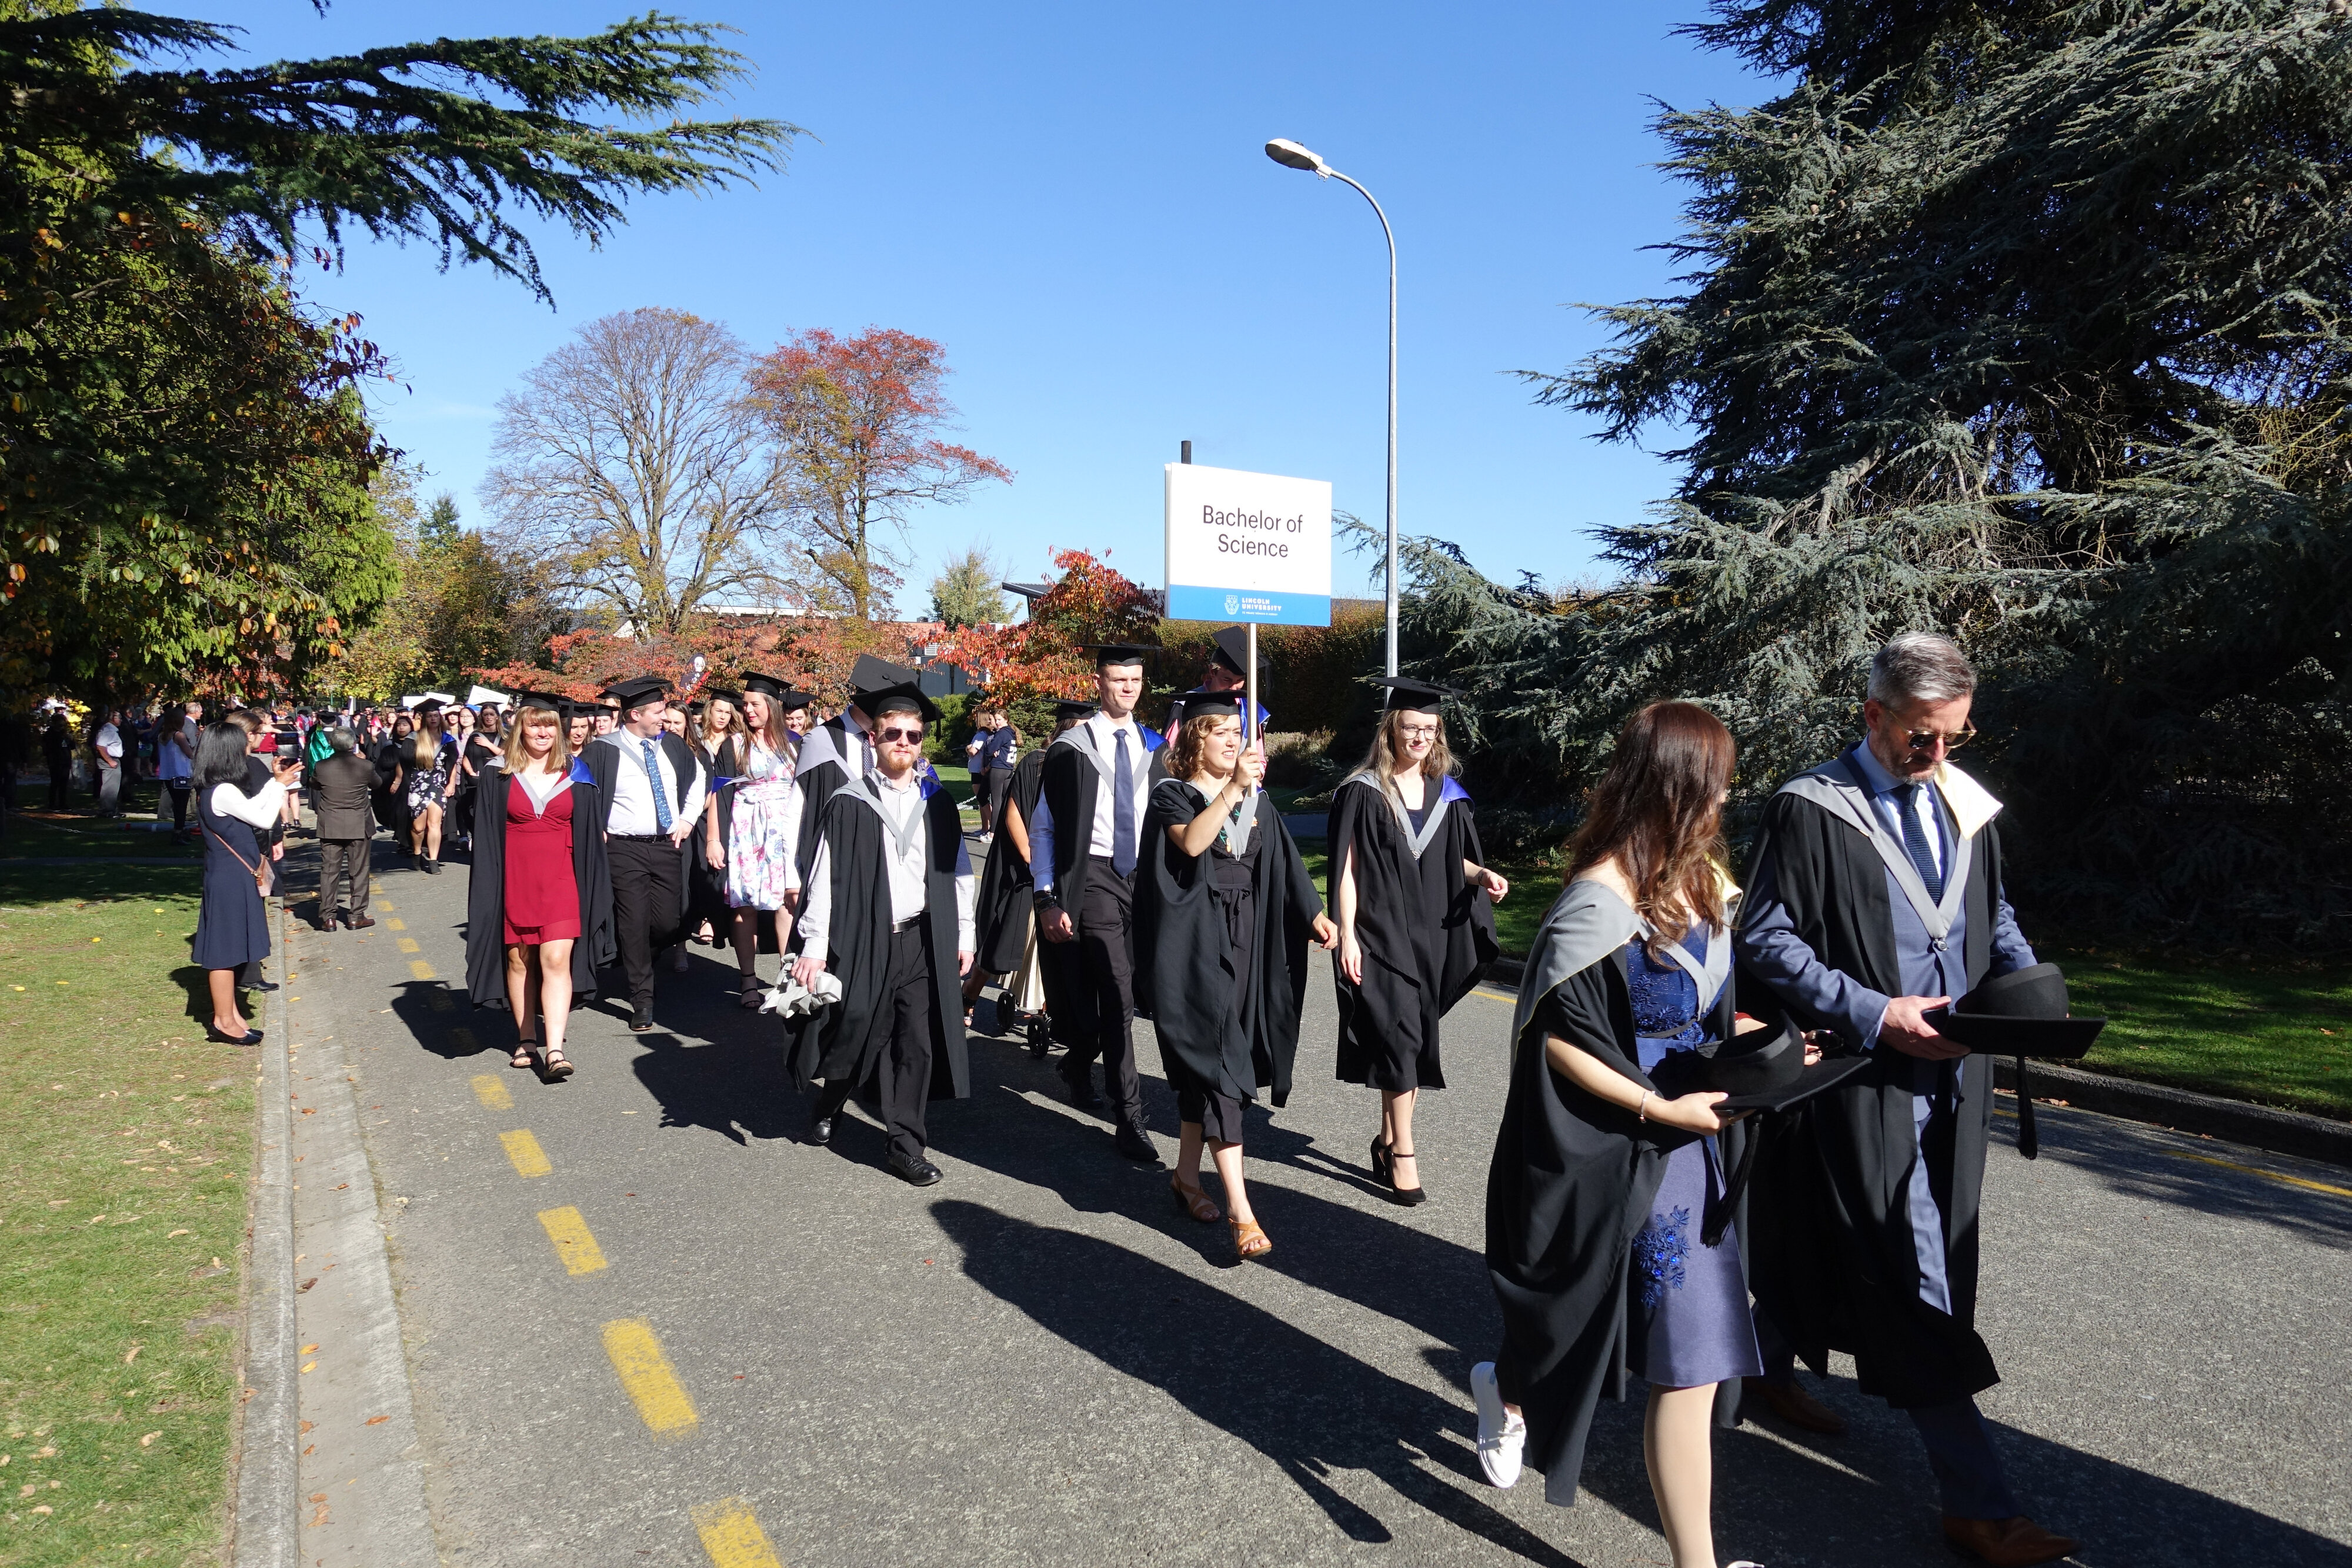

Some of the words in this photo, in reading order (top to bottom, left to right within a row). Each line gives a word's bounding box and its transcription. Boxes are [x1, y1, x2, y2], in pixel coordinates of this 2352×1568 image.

[1203, 505, 1282, 531] Bachelor
[1286, 514, 1303, 533] of
[1217, 533, 1289, 558] Science
[1242, 603, 1282, 612] UNIVERSITY
